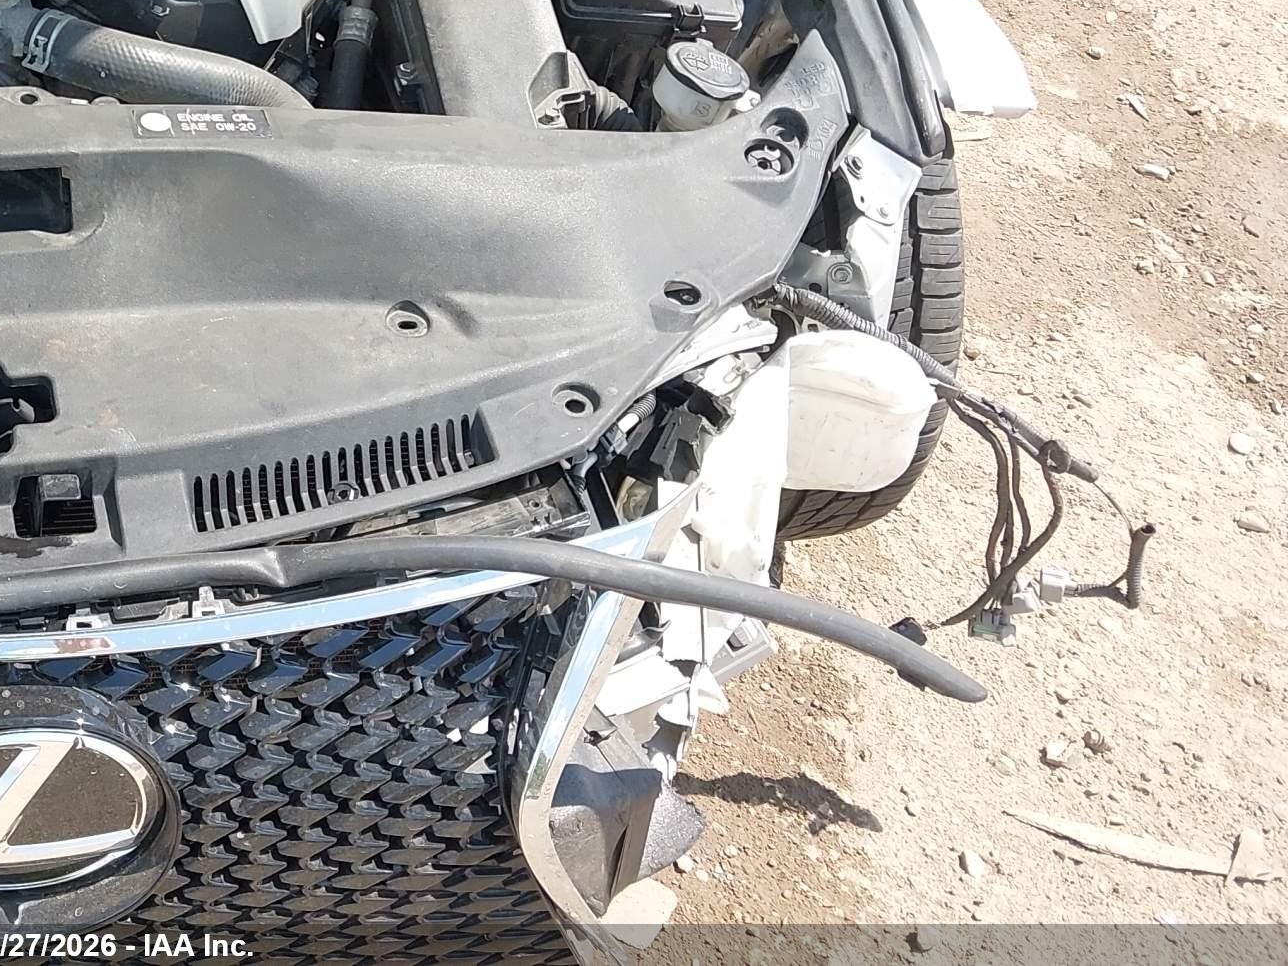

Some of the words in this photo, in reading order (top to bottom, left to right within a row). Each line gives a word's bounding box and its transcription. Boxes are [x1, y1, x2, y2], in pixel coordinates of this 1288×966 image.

[176, 113, 225, 122] ENGINE
[231, 113, 255, 122] OIL
[181, 122, 209, 132] SAE
[215, 122, 257, 132] 0W-20
